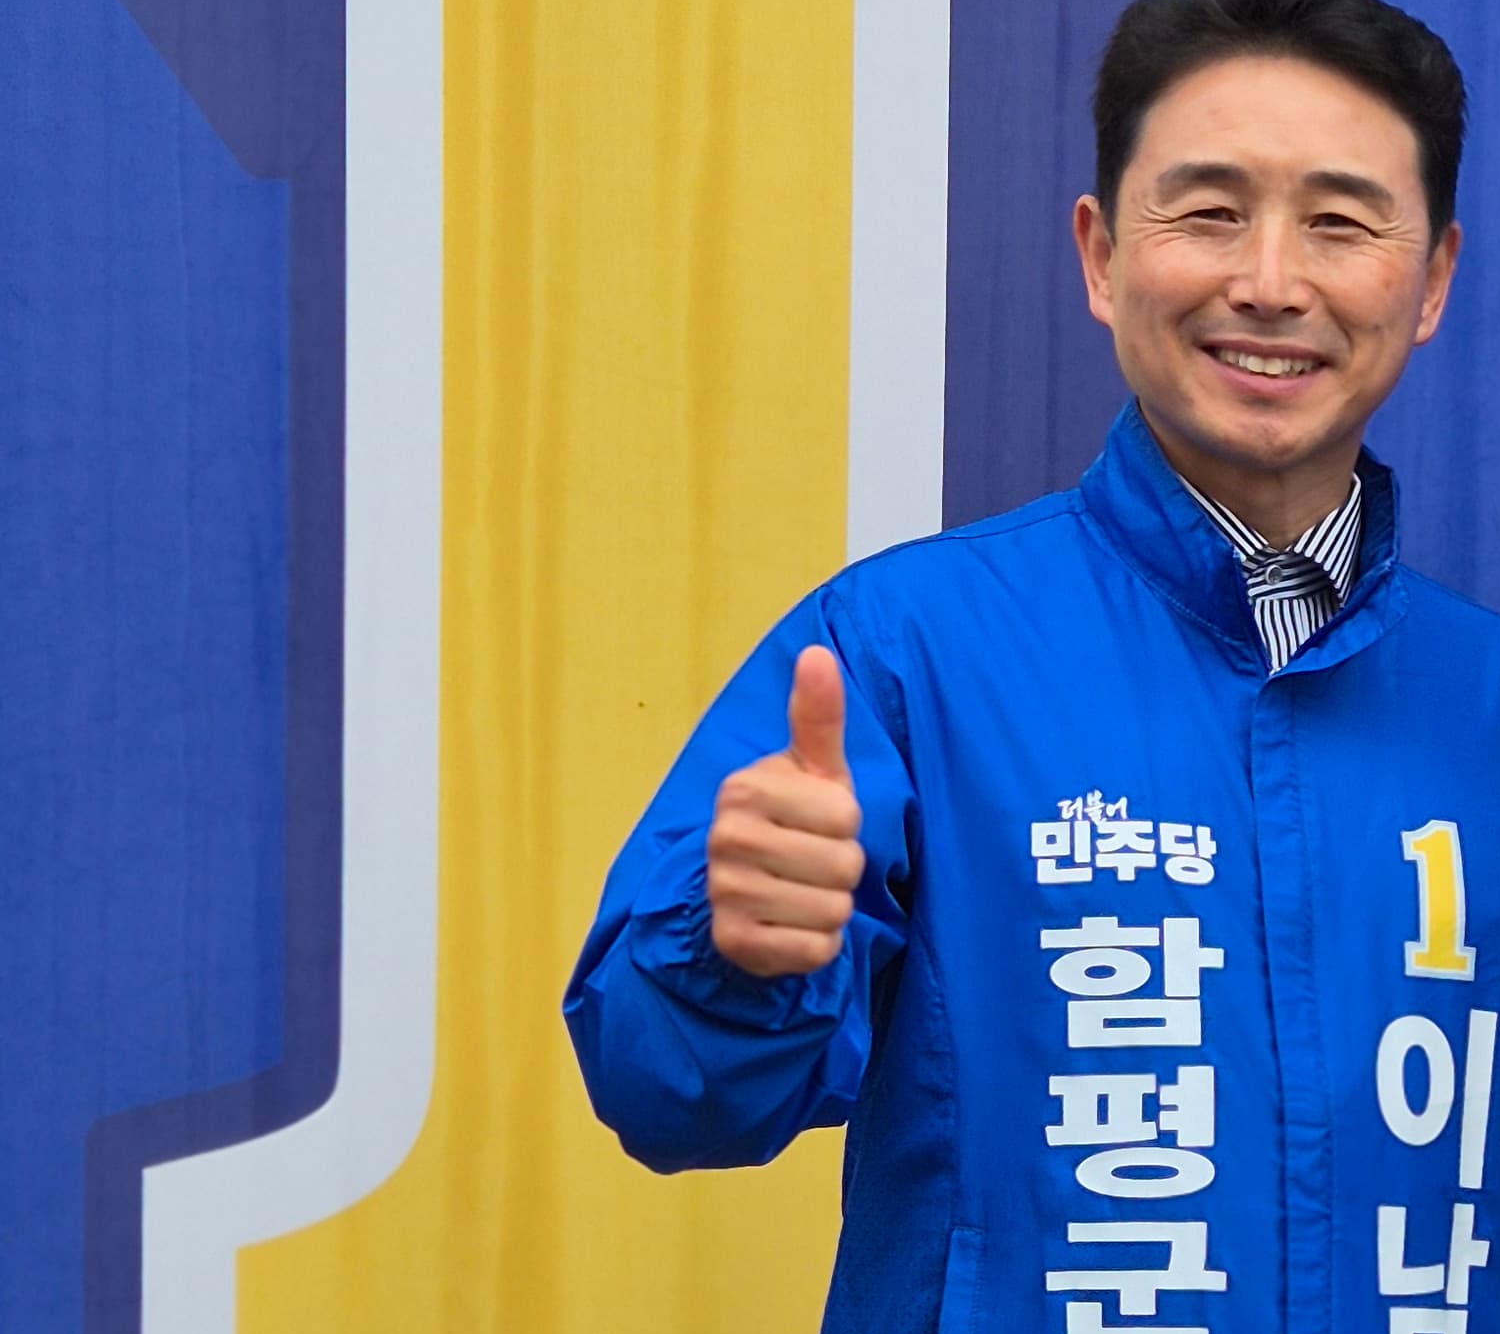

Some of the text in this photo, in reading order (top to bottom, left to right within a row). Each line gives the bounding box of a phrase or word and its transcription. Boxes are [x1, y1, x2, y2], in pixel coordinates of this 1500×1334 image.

[1056, 789, 1128, 827] 더불어
[1031, 820, 1217, 885] 민주당
[1401, 819, 1477, 982] 1
